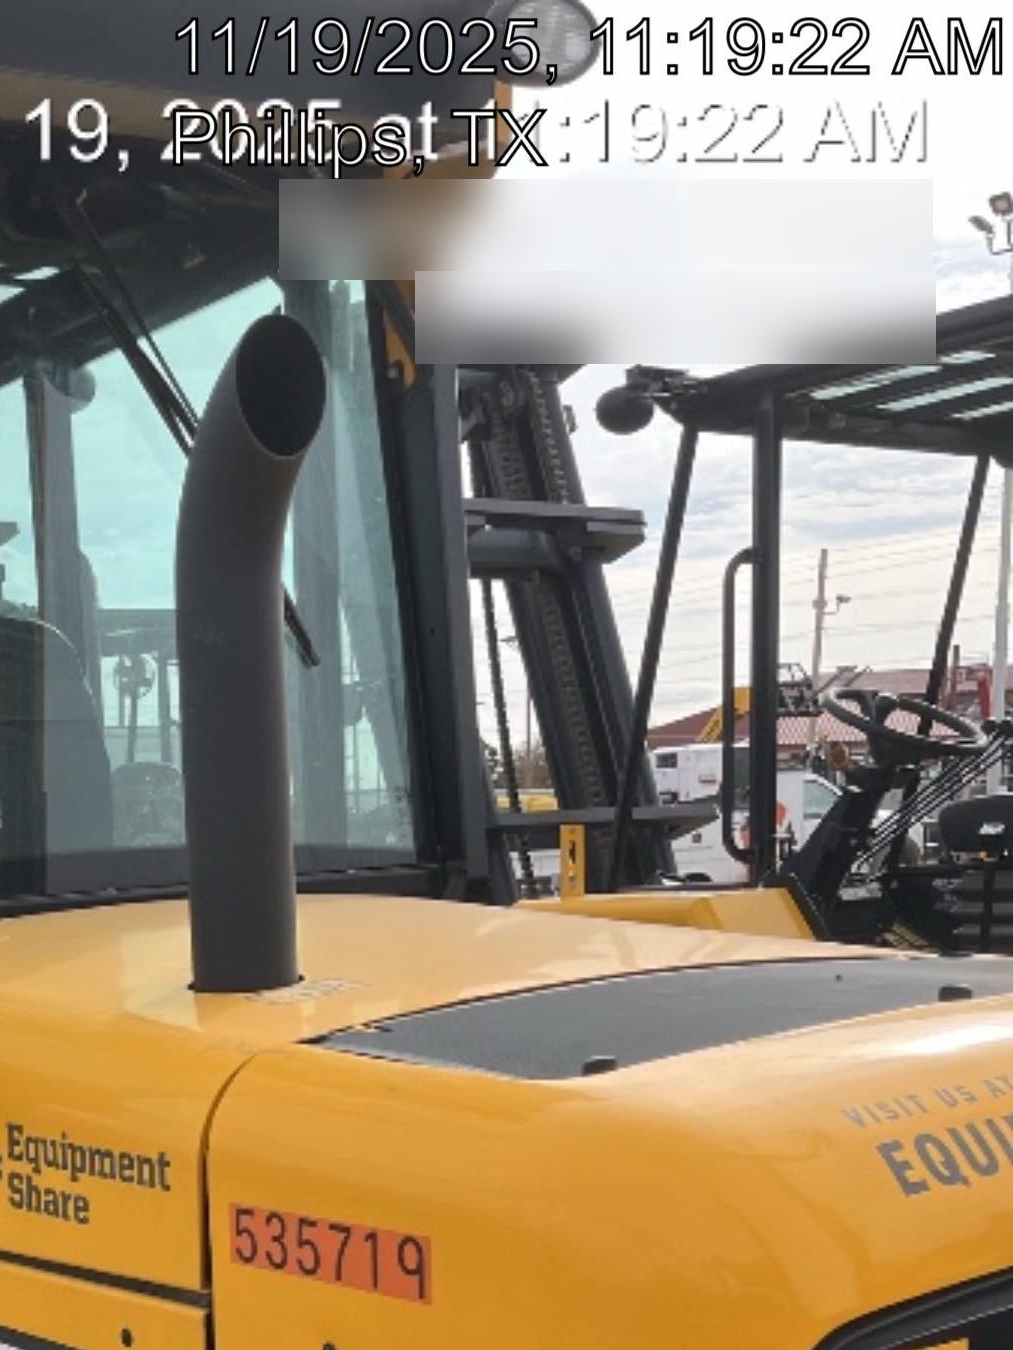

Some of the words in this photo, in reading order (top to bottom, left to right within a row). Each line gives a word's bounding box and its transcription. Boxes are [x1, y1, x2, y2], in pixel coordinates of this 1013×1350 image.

[841, 1093, 930, 1129] VISIT
[934, 1084, 979, 1109] US
[5, 1122, 172, 1192] Equipment
[875, 1113, 1013, 1198] EQUI
[7, 1171, 90, 1226] Share
[234, 1207, 425, 1301] 535719
